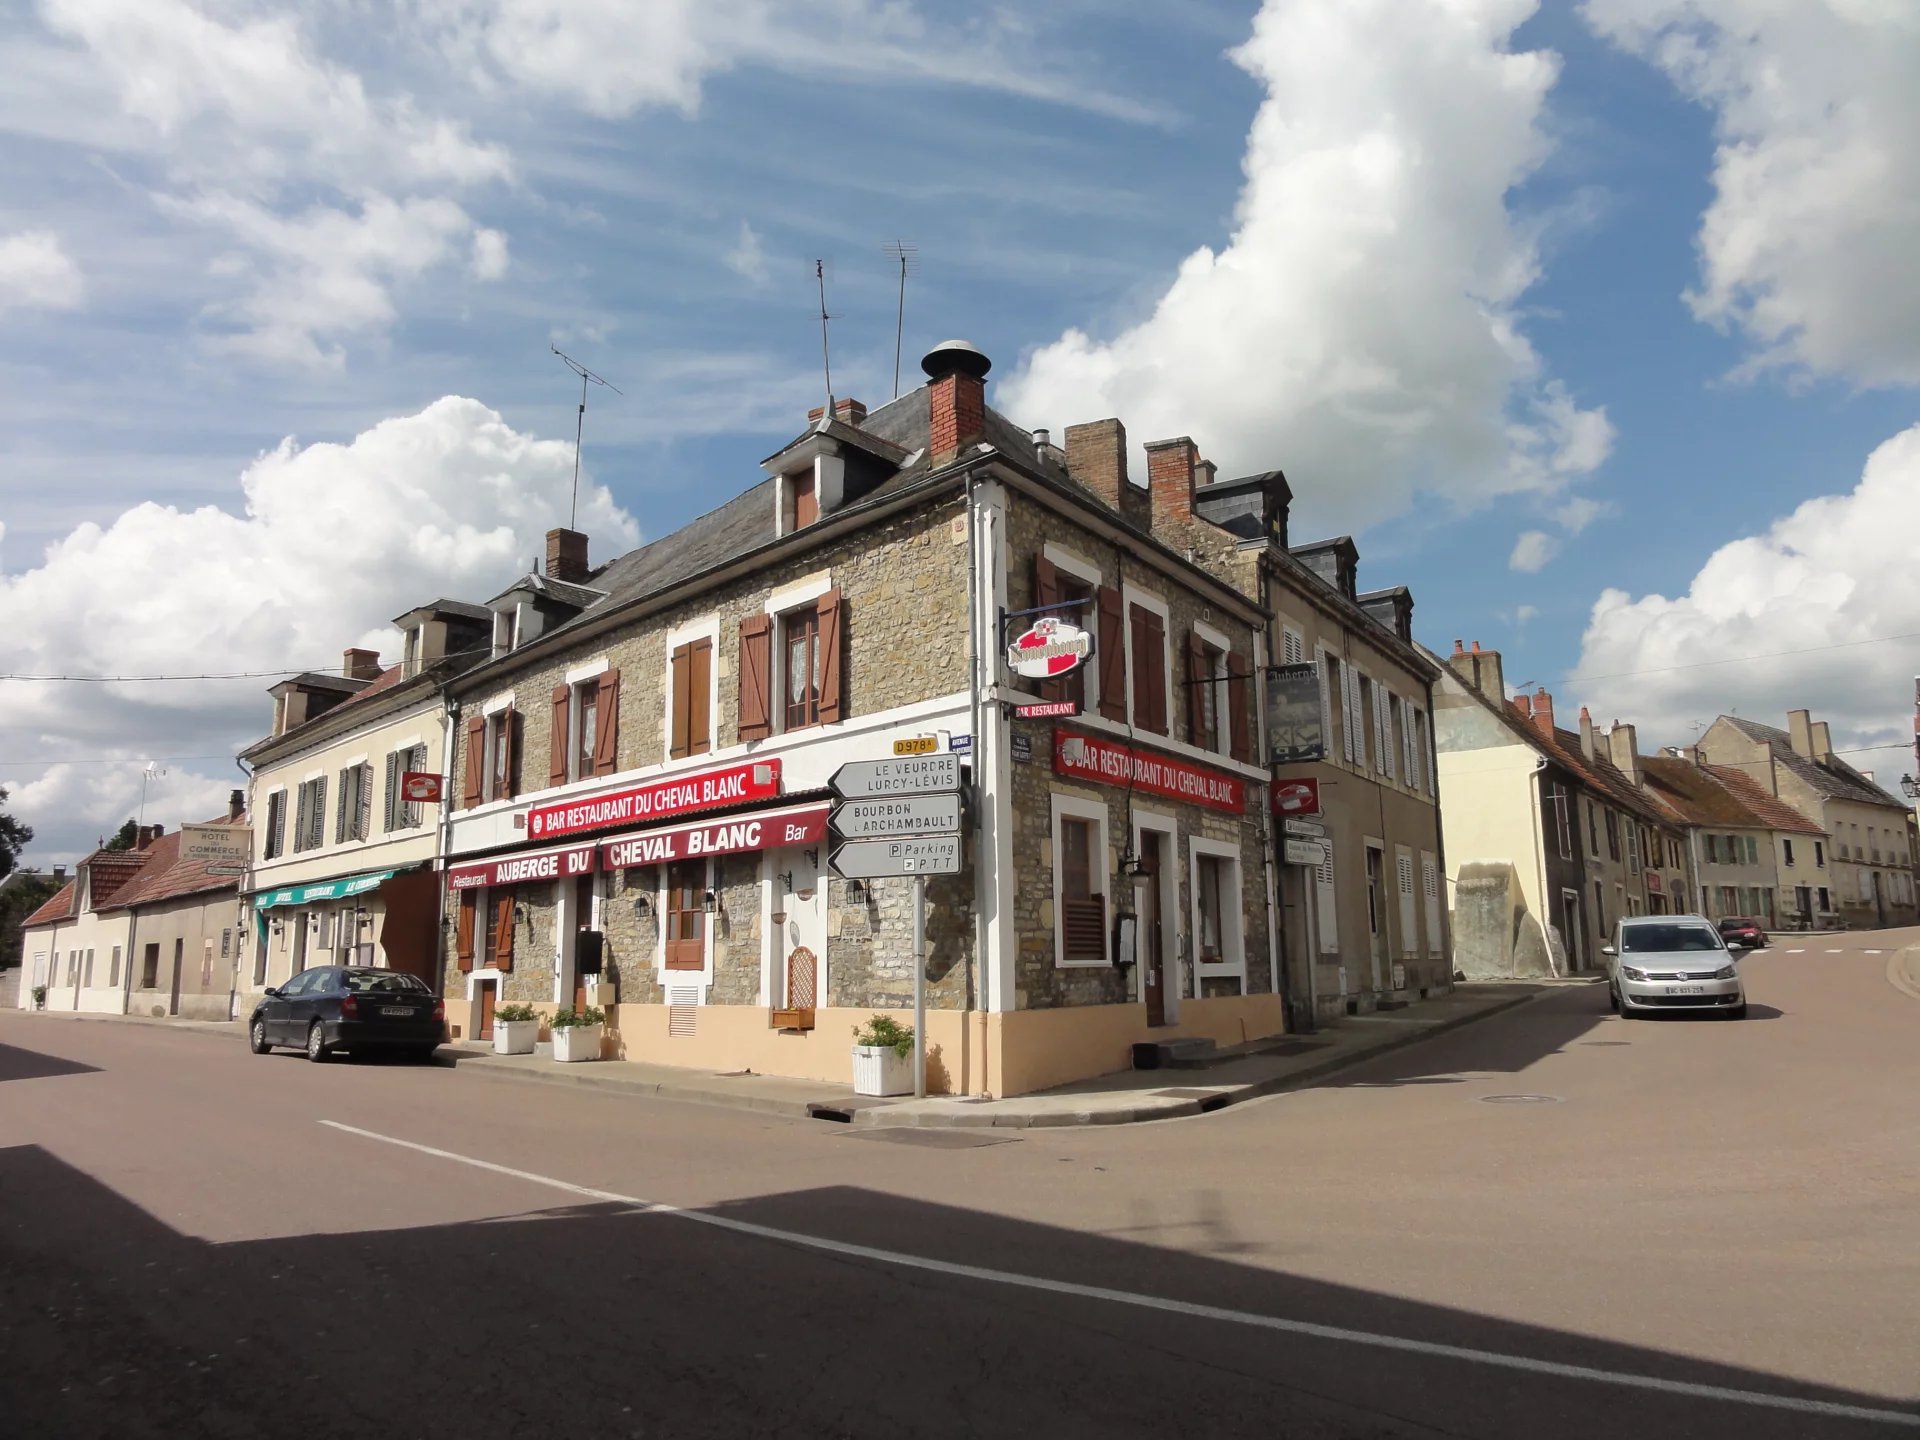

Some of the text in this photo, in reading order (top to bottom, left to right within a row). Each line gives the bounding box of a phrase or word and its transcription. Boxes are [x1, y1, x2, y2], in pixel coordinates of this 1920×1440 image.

[1031, 702, 1074, 717] RESTAURANT
[952, 736, 969, 746] AVENUE
[875, 760, 953, 776] LE VEURDRE
[868, 774, 953, 791] LURCY-LÉVIS
[1100, 751, 1162, 786] RESTAURANT
[1163, 767, 1176, 790] DU
[1178, 771, 1208, 798] CHEVAL
[1209, 779, 1233, 805] BLANC
[546, 811, 565, 831] BAR
[567, 797, 633, 827] RESTAURANT
[635, 792, 652, 814] DU
[654, 781, 700, 811] CHEVAL
[703, 772, 747, 802] BLANC
[854, 804, 911, 817] BOURBON
[863, 815, 954, 832] ARCHAMBAULT
[201, 833, 230, 841] HOTEL
[610, 821, 808, 866] CHEVAL BLANC Bar
[189, 846, 240, 855] COMMERCE
[905, 843, 954, 855] Parking
[453, 850, 590, 888] Restaurant AUBERGE DU
